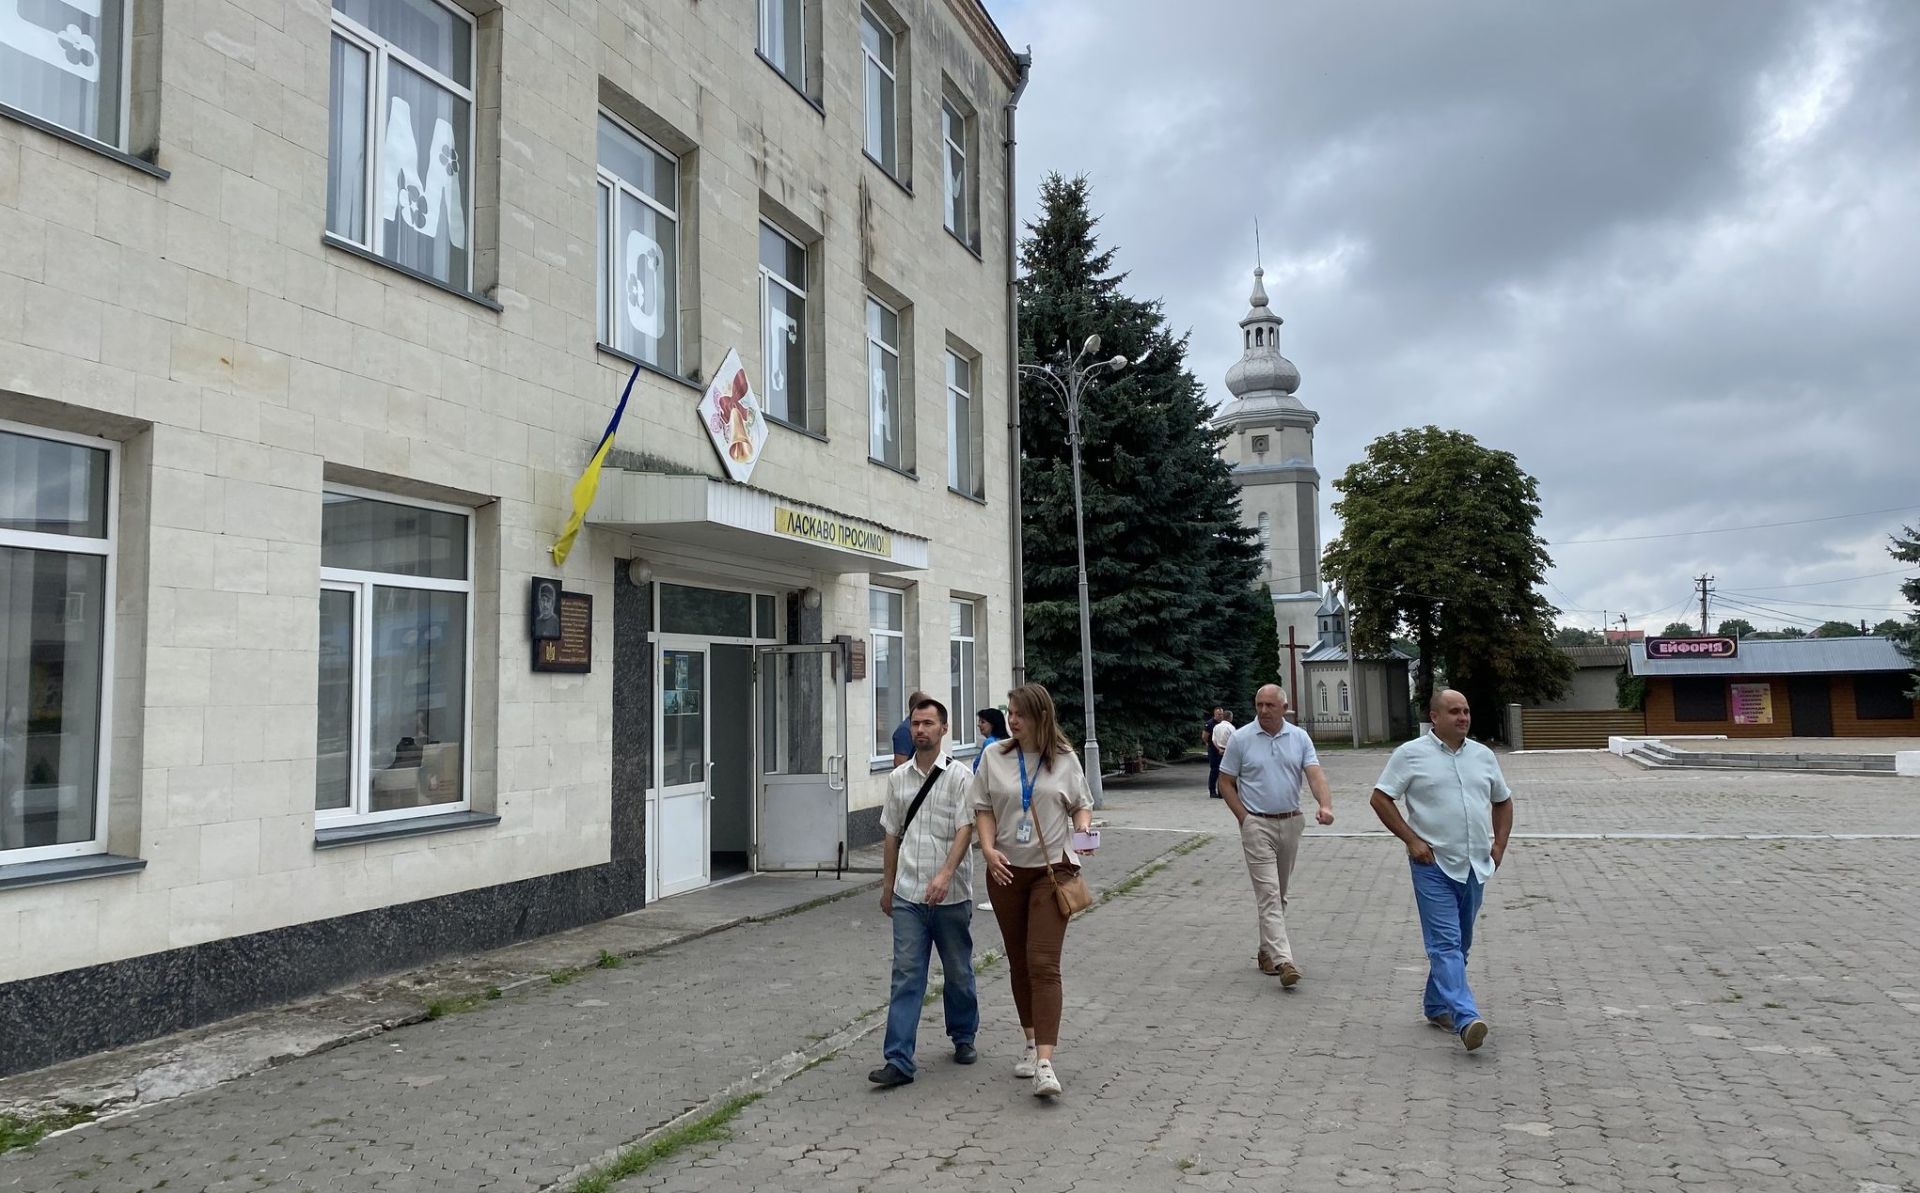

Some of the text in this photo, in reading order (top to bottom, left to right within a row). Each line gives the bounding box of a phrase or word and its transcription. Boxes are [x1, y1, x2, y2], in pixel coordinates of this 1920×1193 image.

[787, 512, 885, 553] ЛАСКАВО ПРОСИМО!
[1659, 641, 1723, 653] ЕЙФОРІЯ
